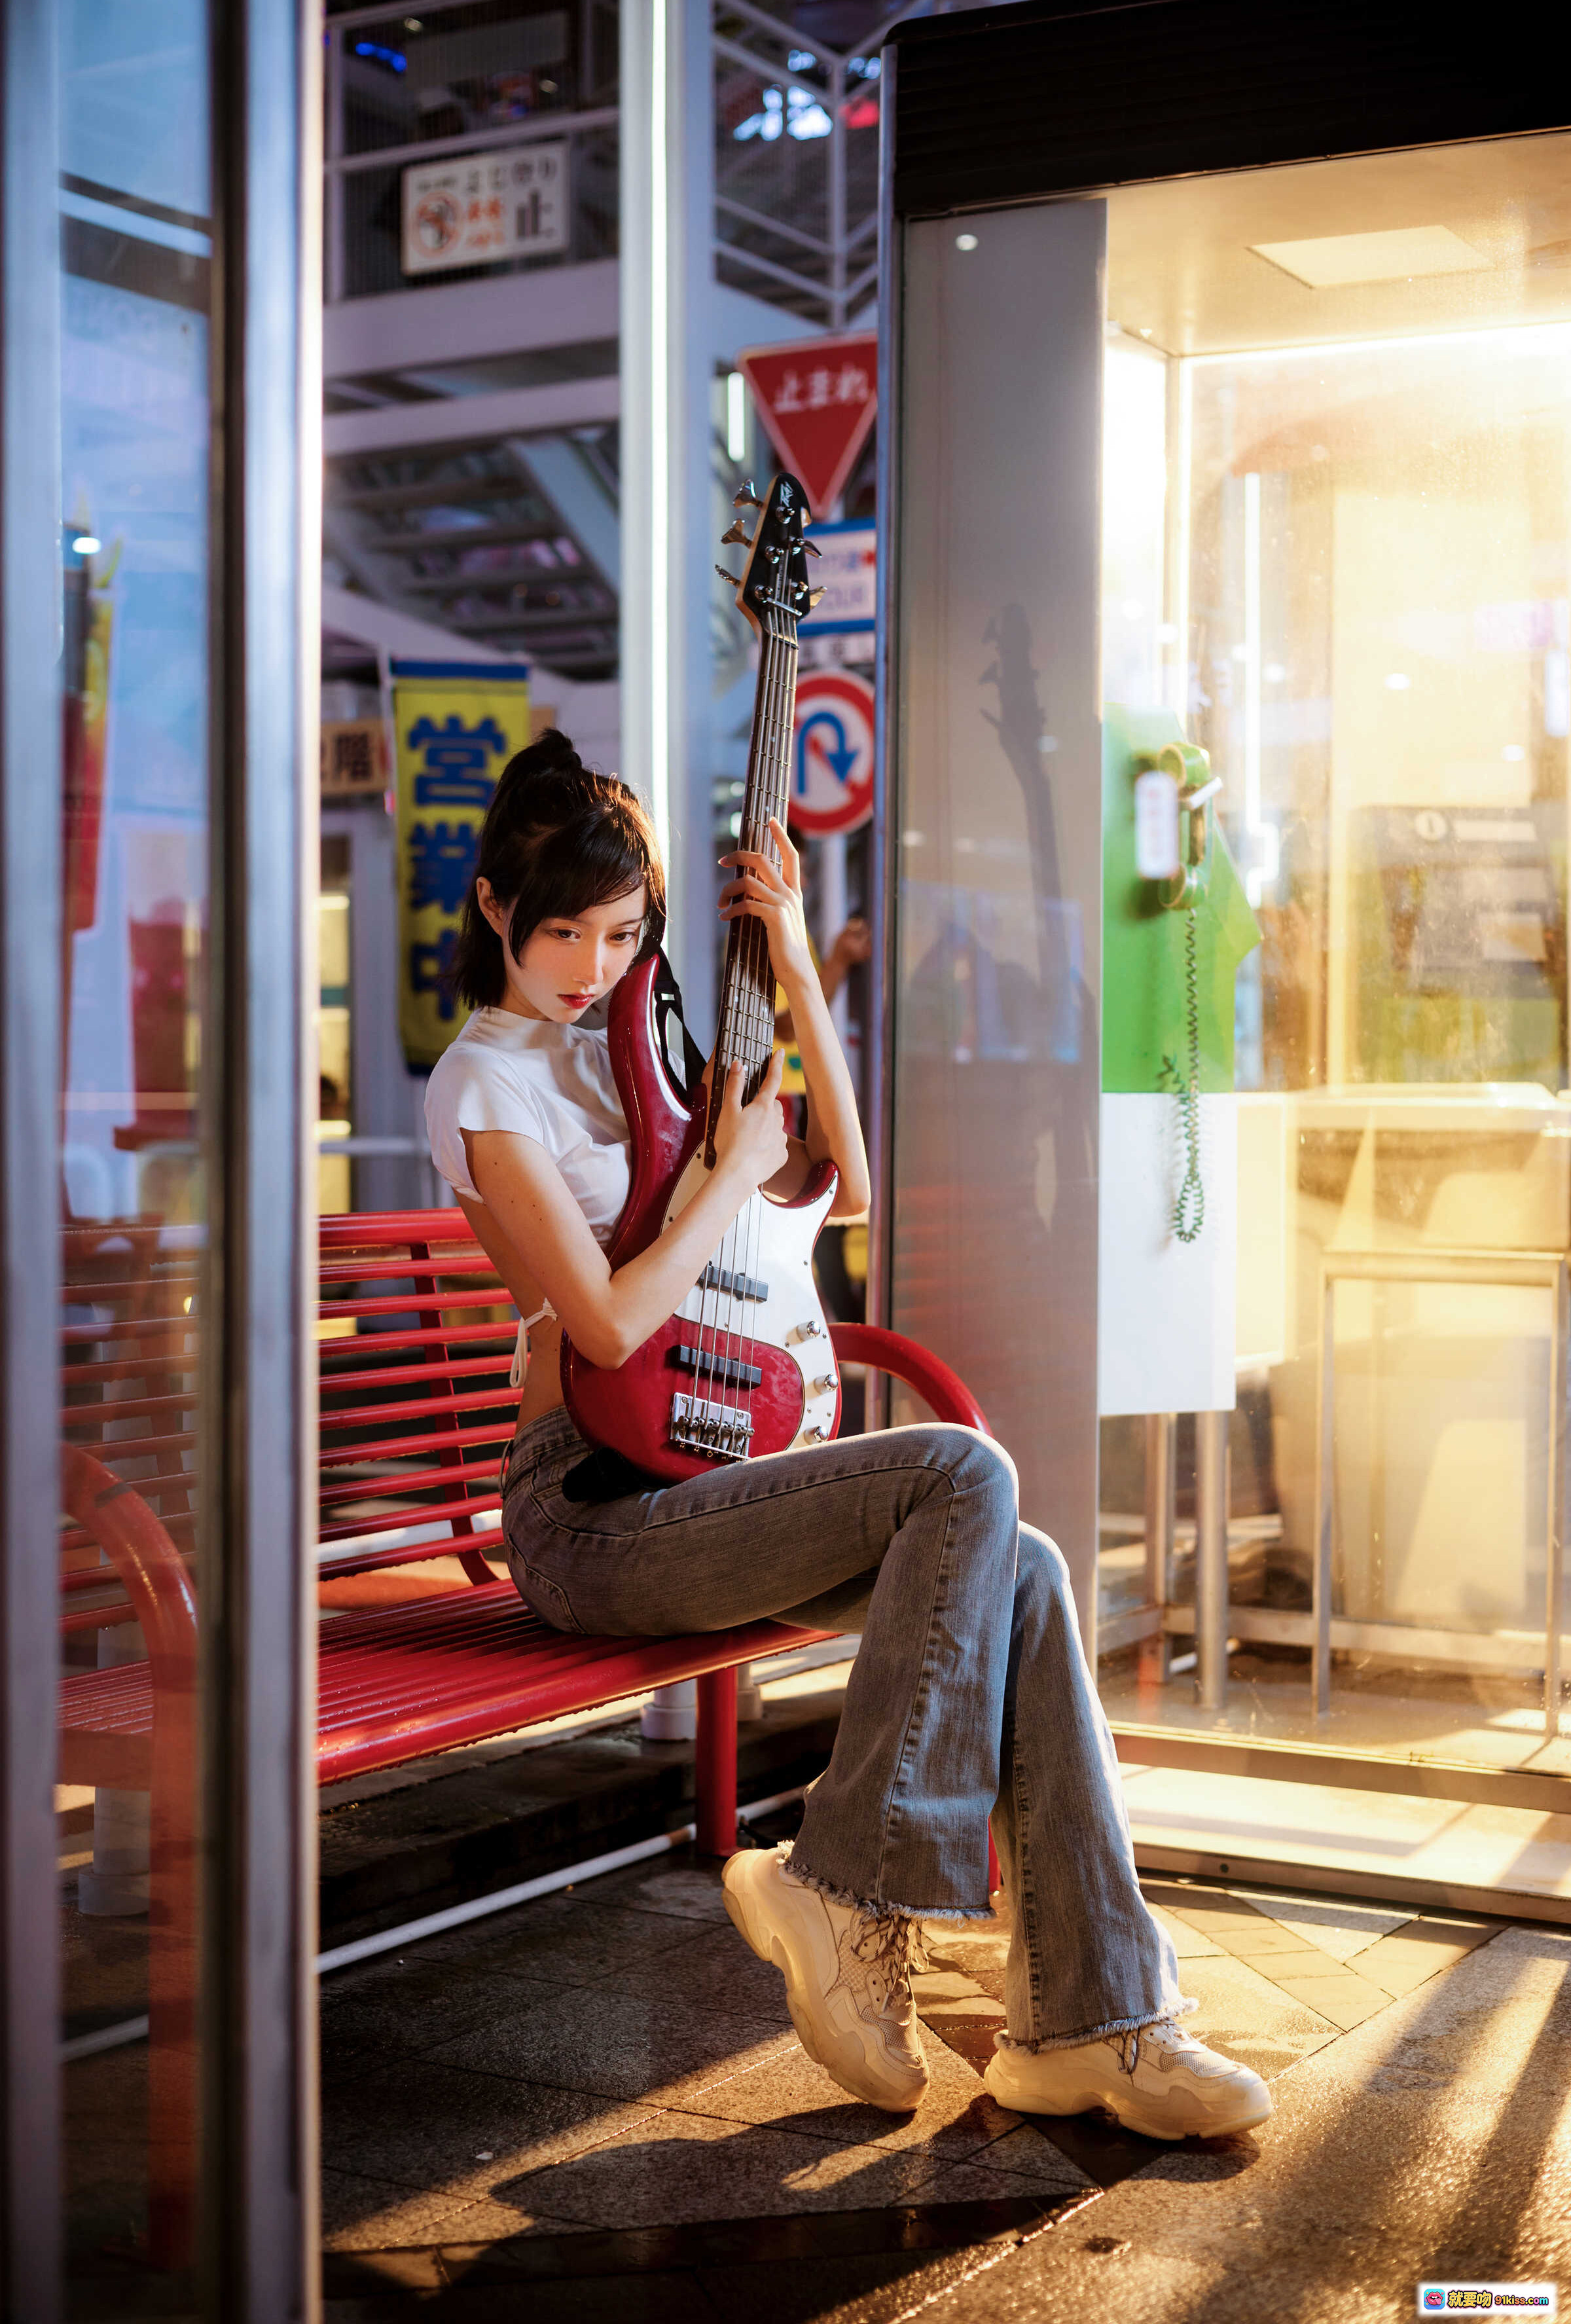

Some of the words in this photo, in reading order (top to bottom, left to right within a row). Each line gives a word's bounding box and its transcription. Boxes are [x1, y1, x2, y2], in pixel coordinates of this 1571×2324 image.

[774, 361, 871, 414] 止まれ
[406, 714, 507, 1022] 営業中
